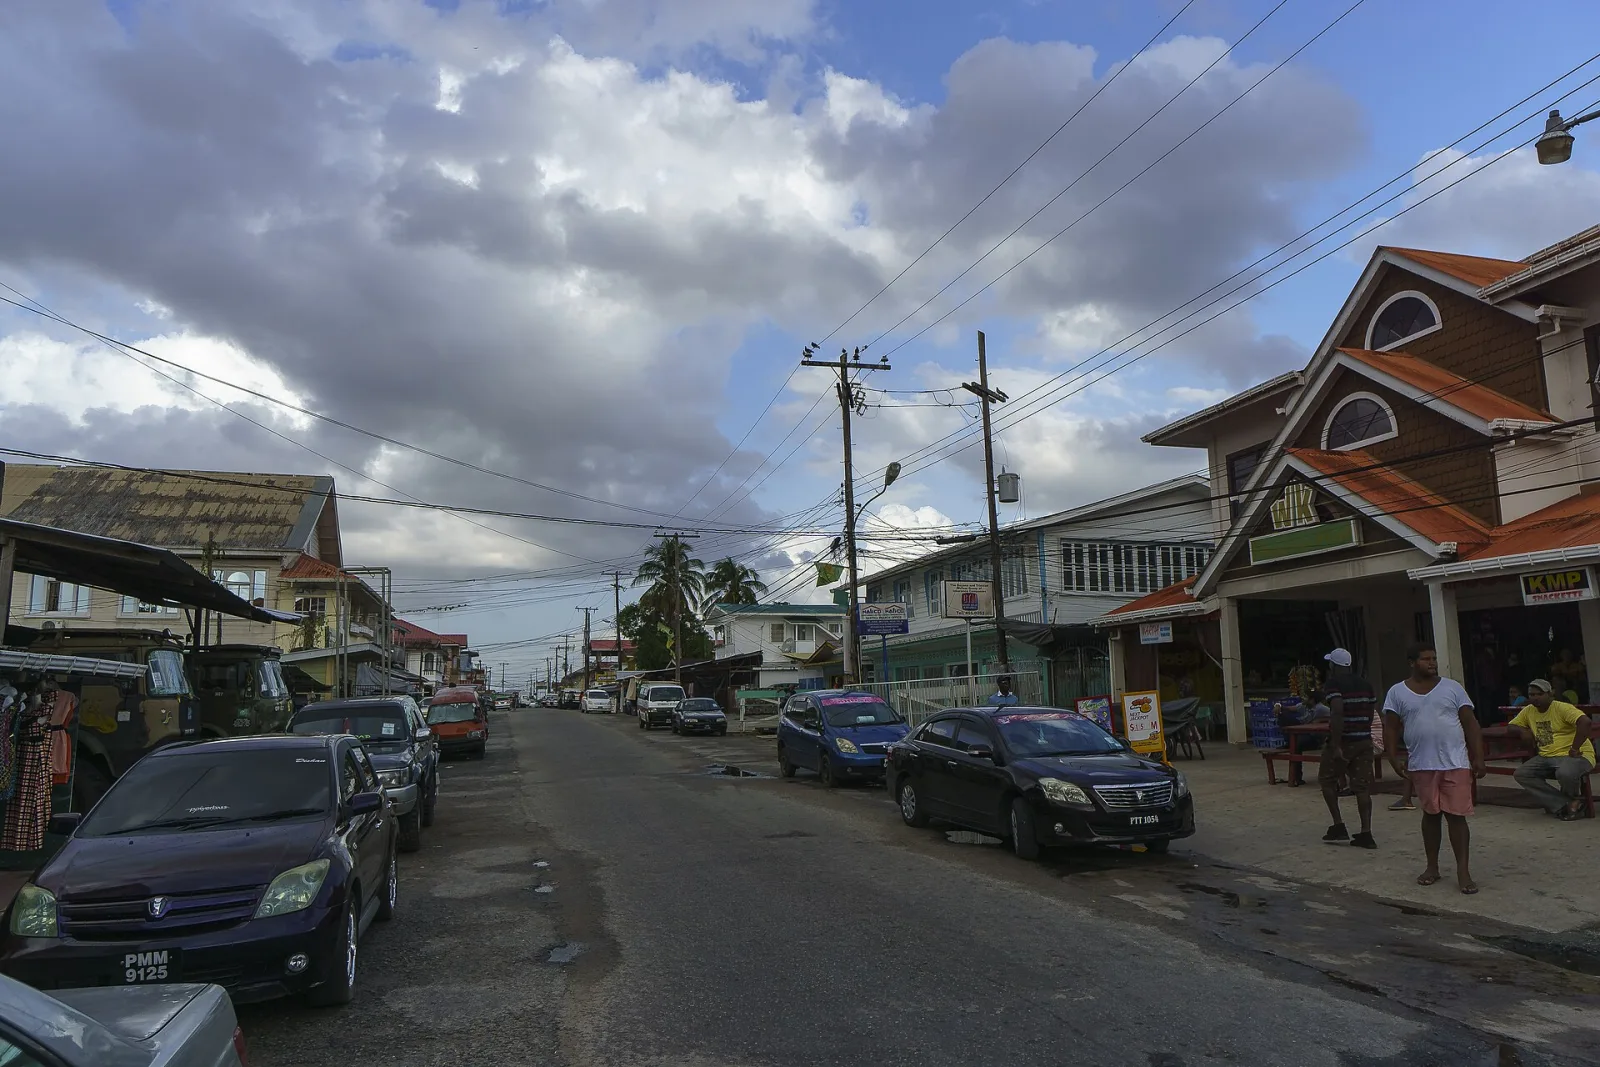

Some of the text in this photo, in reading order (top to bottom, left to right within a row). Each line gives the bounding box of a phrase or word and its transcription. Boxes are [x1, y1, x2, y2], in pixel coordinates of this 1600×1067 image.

[1529, 571, 1581, 593] KMP
[1532, 590, 1583, 602] SNACKETTE
[1130, 816, 1143, 825] PTT
[125, 950, 168, 968] PMM
[125, 965, 168, 982] 9125
